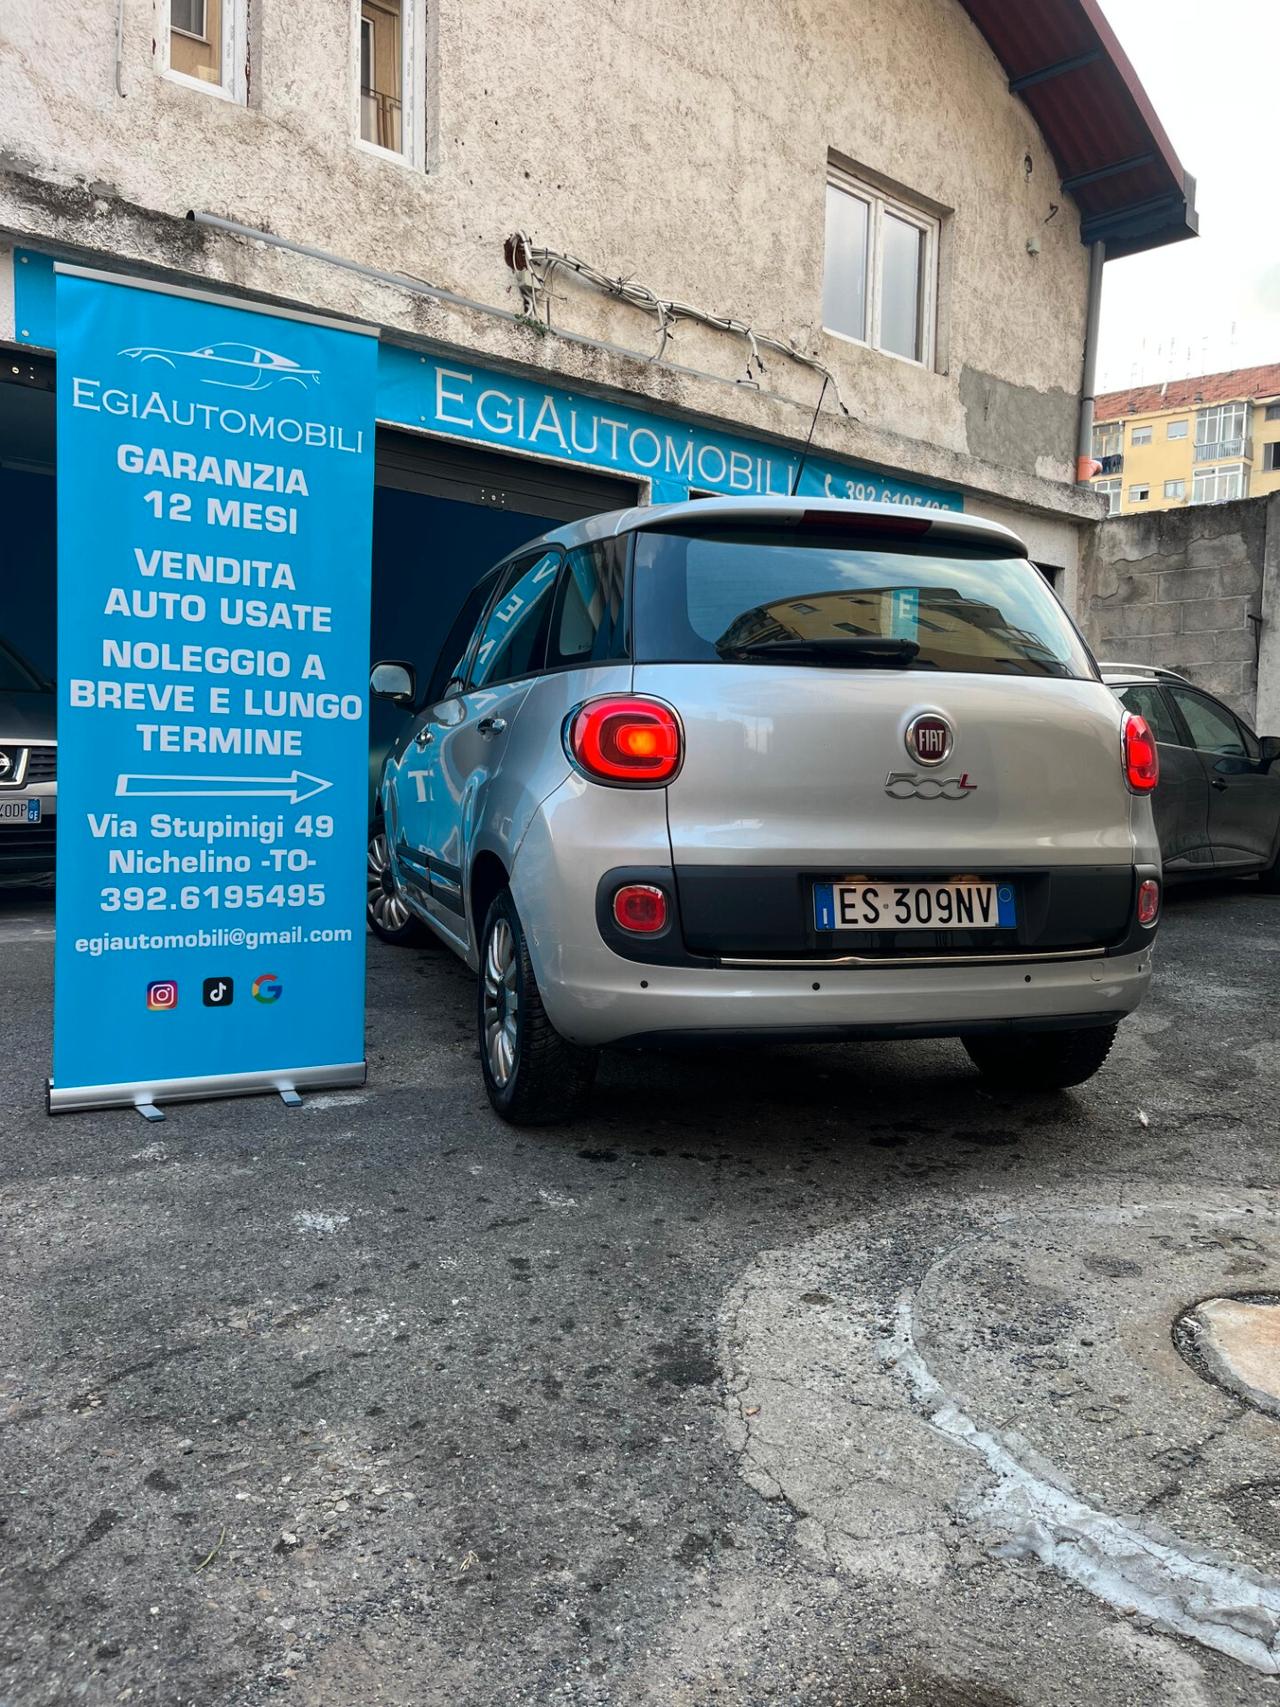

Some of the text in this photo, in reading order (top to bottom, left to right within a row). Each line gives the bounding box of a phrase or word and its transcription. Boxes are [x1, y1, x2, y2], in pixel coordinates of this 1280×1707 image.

[117, 444, 309, 497] GARANZIA
[143, 490, 297, 535] 12 MESI
[134, 548, 296, 591] VENDITA
[104, 588, 332, 633] AUTO USATE
[102, 639, 326, 680] NOLEGGIO A
[70, 679, 363, 720] BREVE E LUNGO
[136, 723, 302, 756] TERMINE
[918, 729, 945, 751] FIAT
[884, 771, 978, 800] 500L
[87, 813, 334, 844] Via Stupinigi 49
[109, 848, 317, 874] Nichelino -TO-
[100, 883, 326, 912] 392.6195495
[839, 887, 992, 924] ES 309NV
[75, 926, 352, 957] egiautomobili@gmail.com
